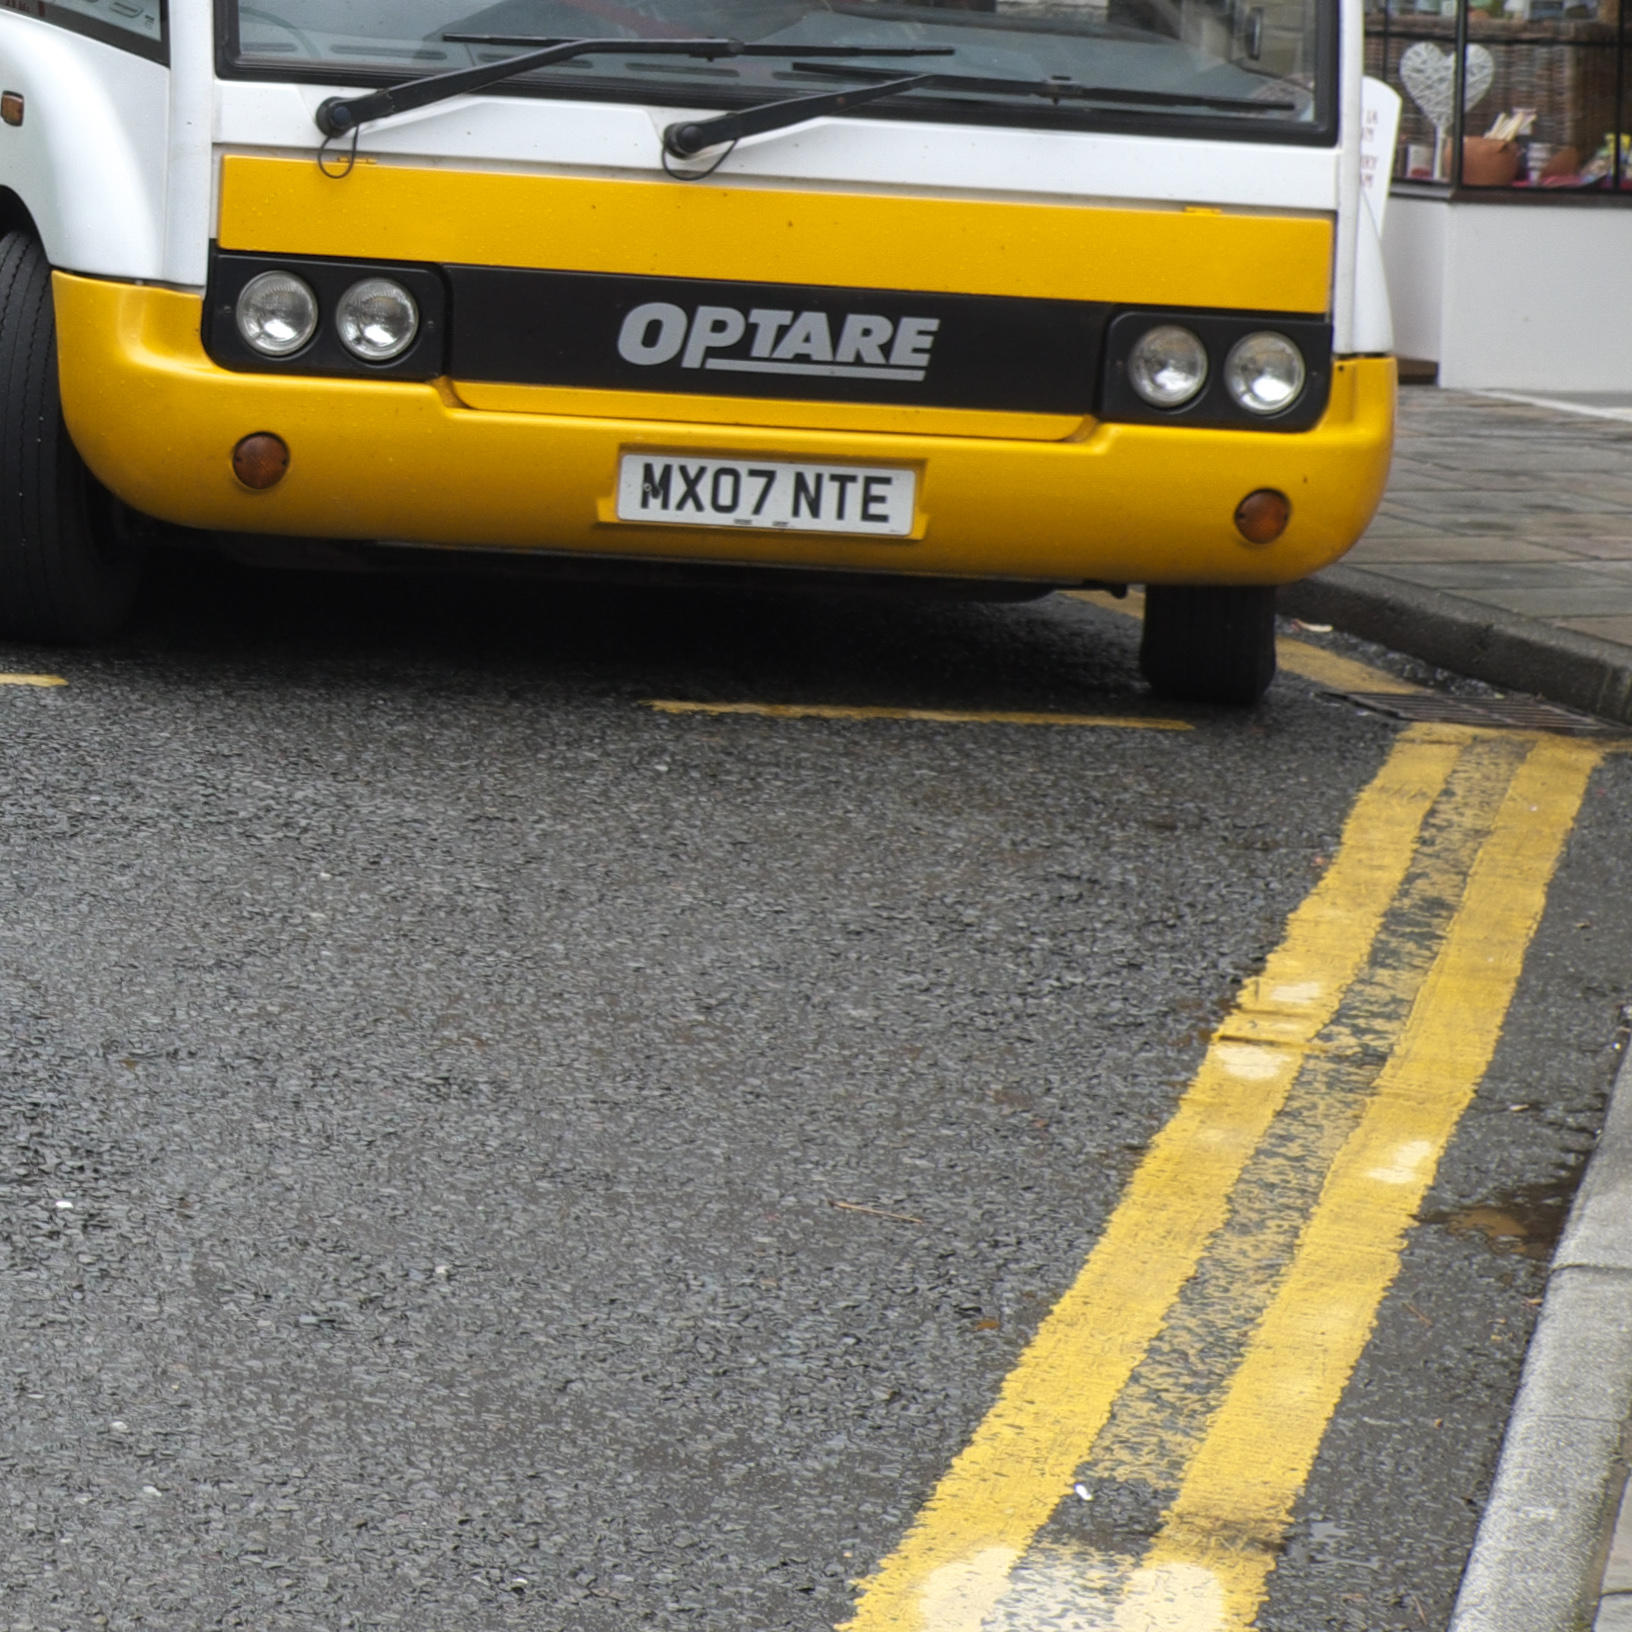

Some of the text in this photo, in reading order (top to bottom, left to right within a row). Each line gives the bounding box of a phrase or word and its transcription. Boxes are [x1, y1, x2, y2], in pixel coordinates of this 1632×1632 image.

[617, 301, 940, 371] OPTARE
[639, 462, 894, 523] MX07 NTE
